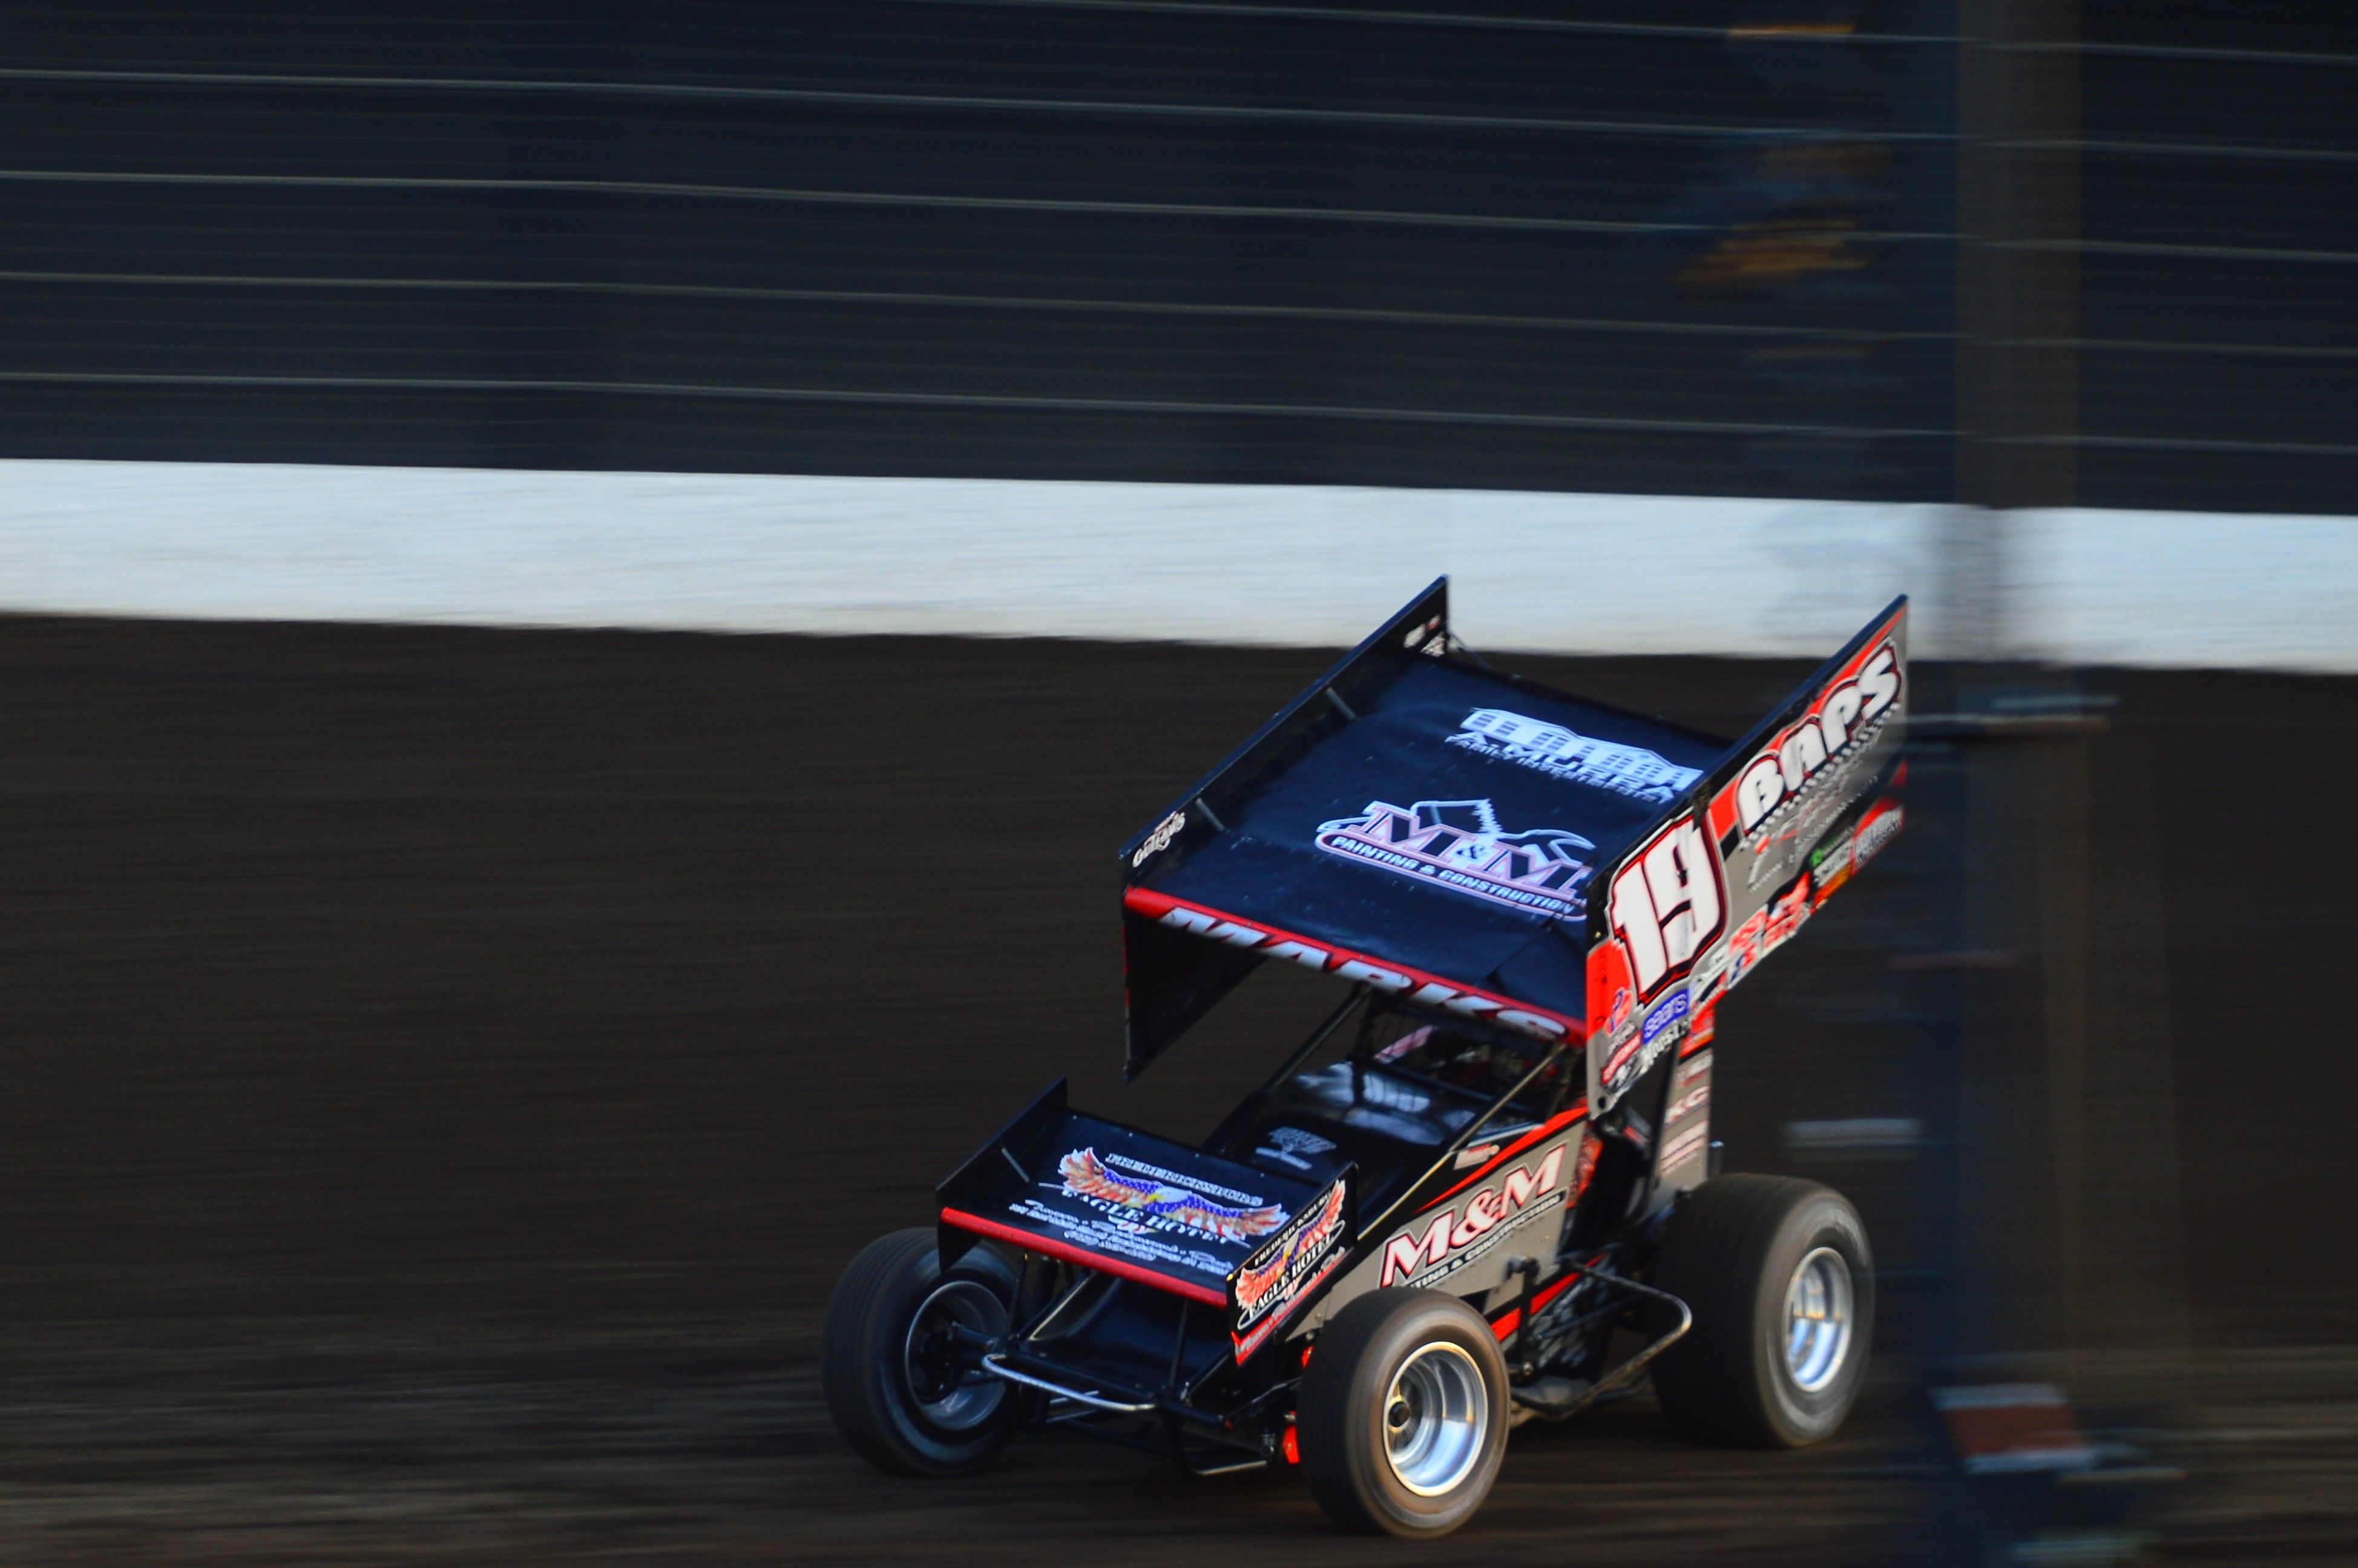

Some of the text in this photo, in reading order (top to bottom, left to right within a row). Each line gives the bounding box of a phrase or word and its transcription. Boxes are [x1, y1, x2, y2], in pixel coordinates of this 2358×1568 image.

[1331, 836, 1574, 914] PAINTING & CONSTRUCTION
[1610, 812, 1725, 1002] 19
[1158, 907, 1566, 1038] MARKS
[1381, 1143, 1567, 1288] M&M
[1249, 1270, 1290, 1319] EAGLE
